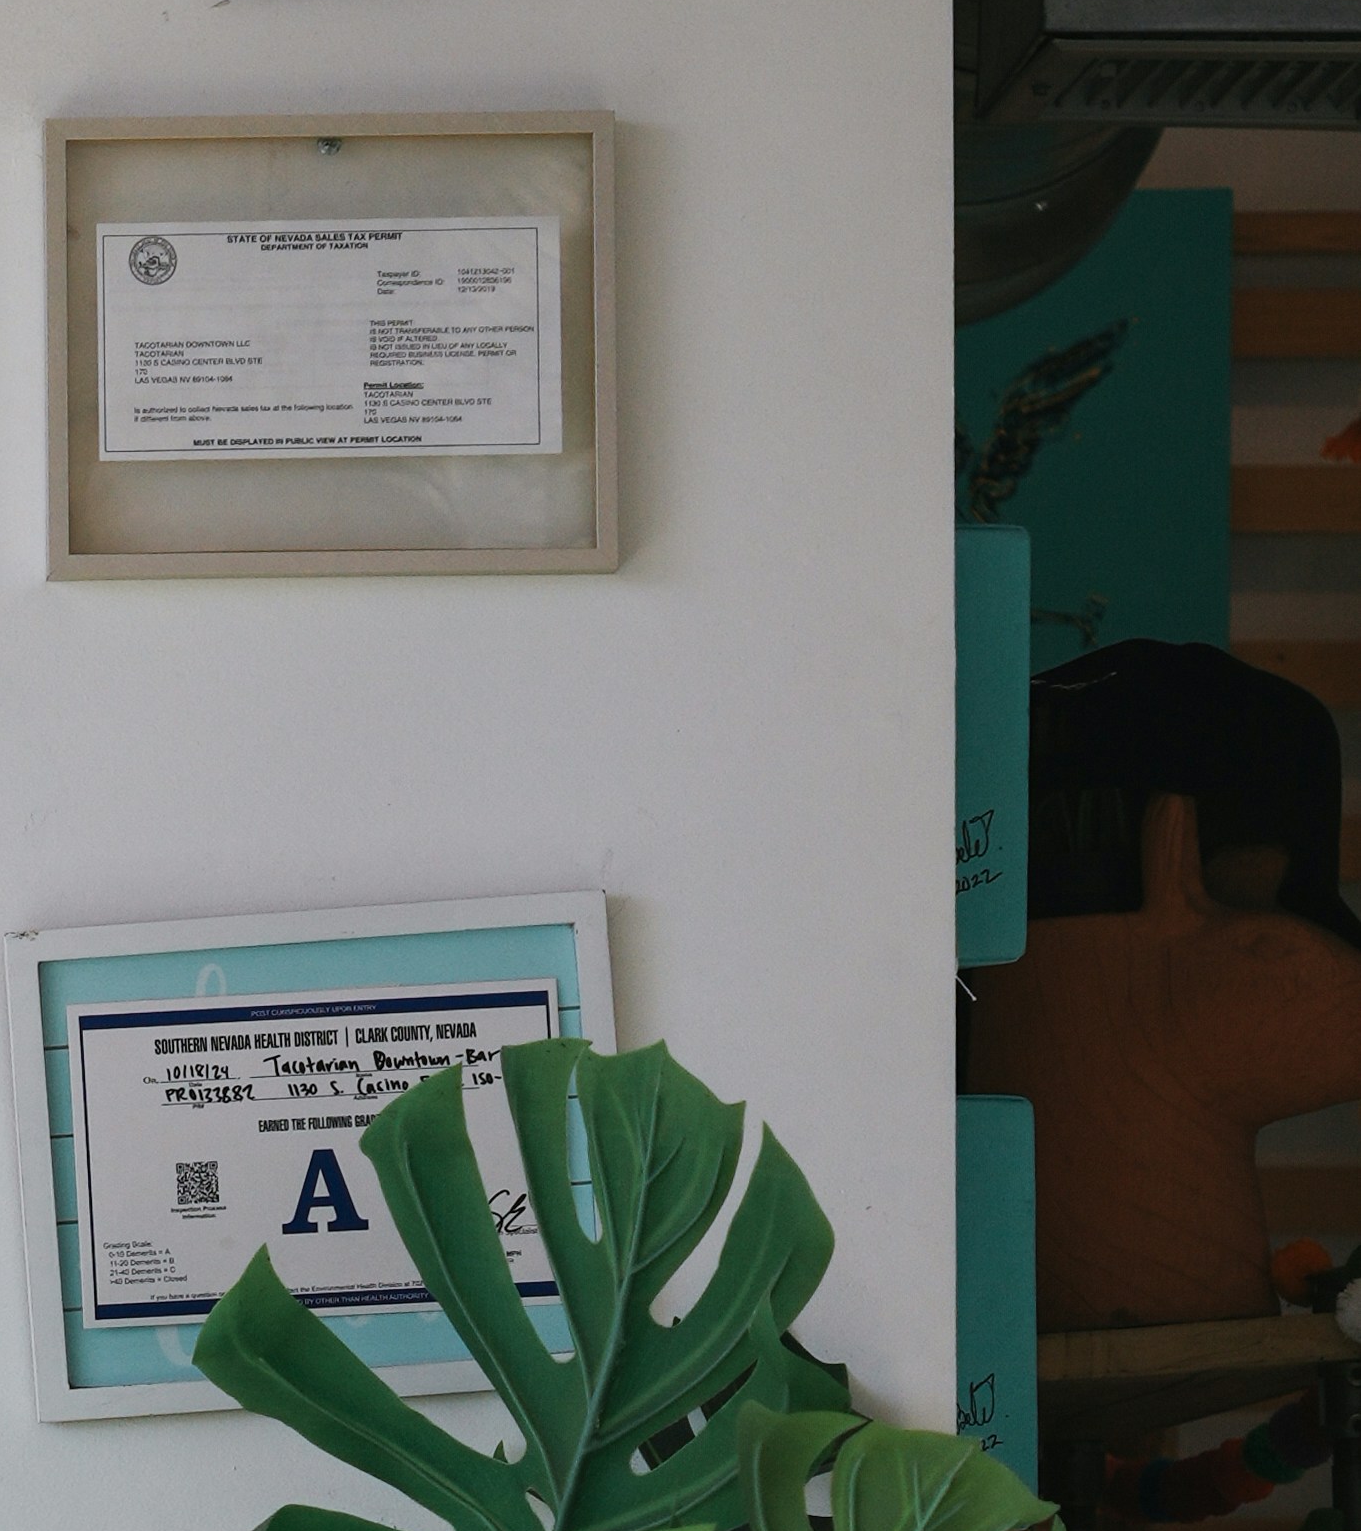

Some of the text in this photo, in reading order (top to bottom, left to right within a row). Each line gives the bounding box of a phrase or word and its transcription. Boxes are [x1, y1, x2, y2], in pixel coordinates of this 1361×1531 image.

[224, 230, 403, 244] STATE OF NEVADA SALES TAX PERMIT
[192, 438, 216, 447] MUST
[216, 438, 229, 446] BE
[229, 437, 275, 446] DISPLAYED
[284, 437, 315, 445] PUBLIC
[315, 437, 336, 445] VIEW
[336, 436, 348, 444] AT
[349, 435, 380, 444] PERMIT
[380, 435, 423, 444] LOCATION
[155, 1022, 476, 1055] SOUTHERN NEVADA HEALTH DISTRICT CLARK COUNTY, NEVADA
[167, 1064, 231, 1082] 10/18/24
[263, 1055, 360, 1075] Tacotarian
[286, 1083, 320, 1099] 1130
[356, 1076, 409, 1094] Casino
[282, 1148, 369, 1234] A
